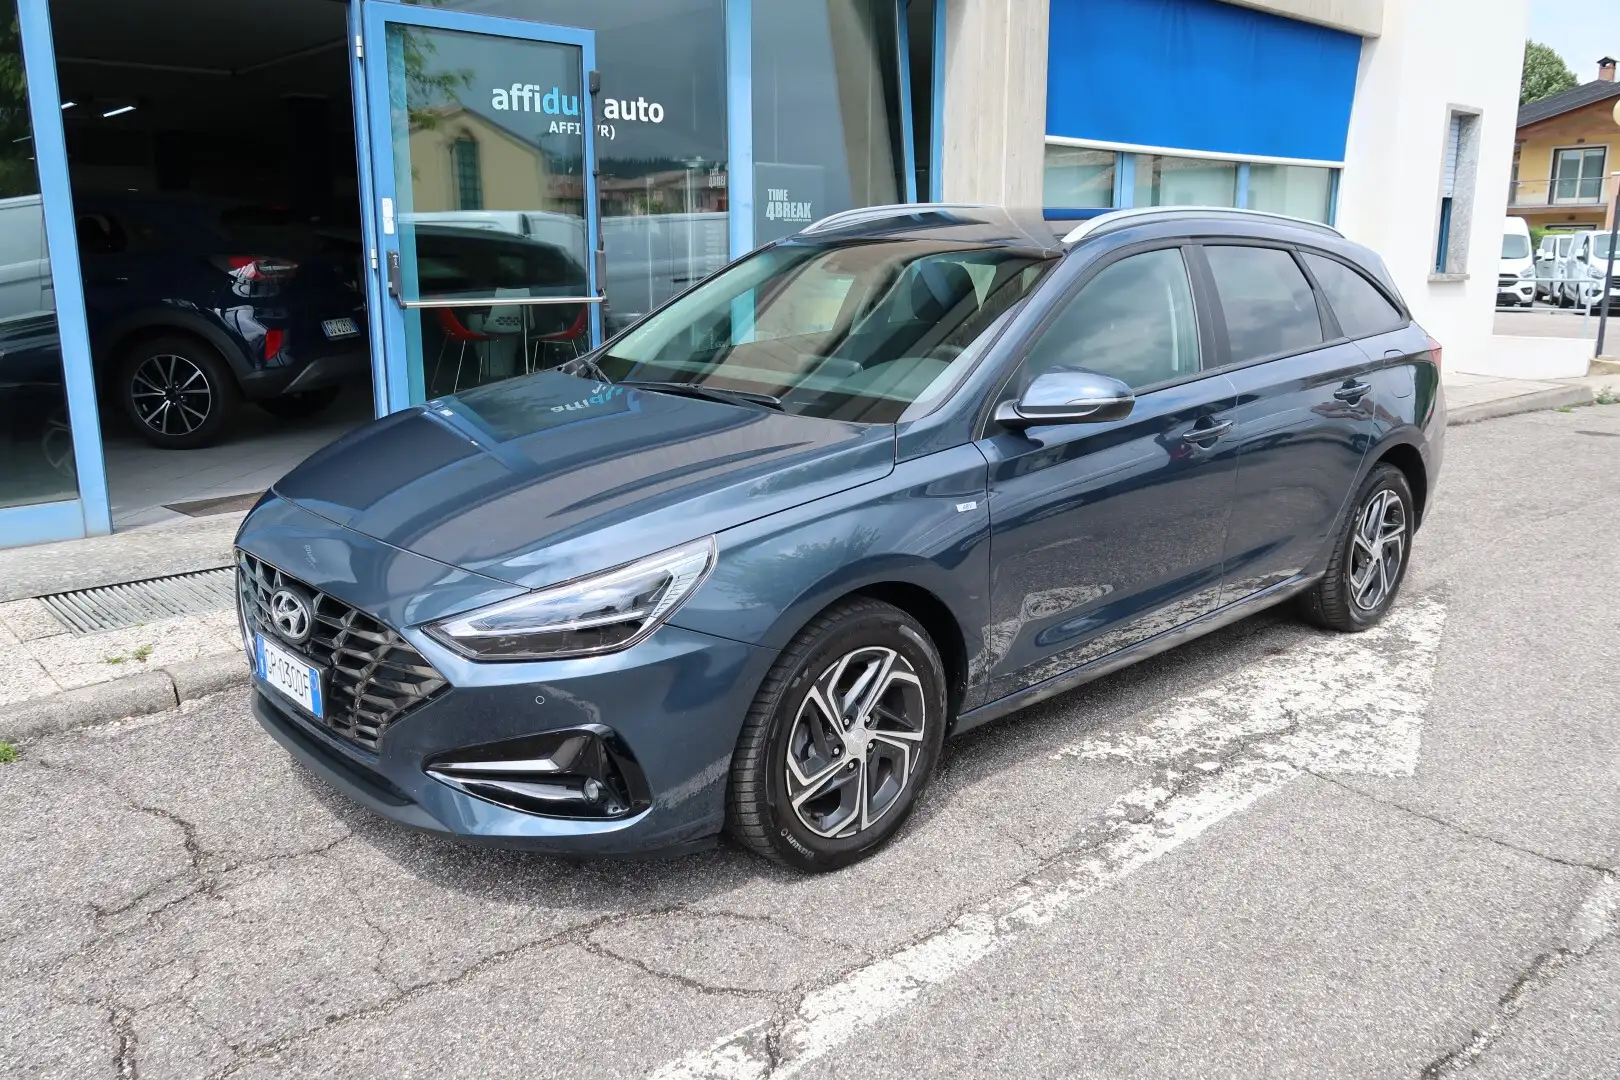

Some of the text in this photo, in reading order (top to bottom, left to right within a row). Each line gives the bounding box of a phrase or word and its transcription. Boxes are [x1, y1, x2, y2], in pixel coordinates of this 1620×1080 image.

[491, 83, 664, 123] affidu auto
[548, 121, 615, 140] AFFI R)
[767, 188, 788, 201] TIME
[765, 201, 812, 220] 4BREAK
